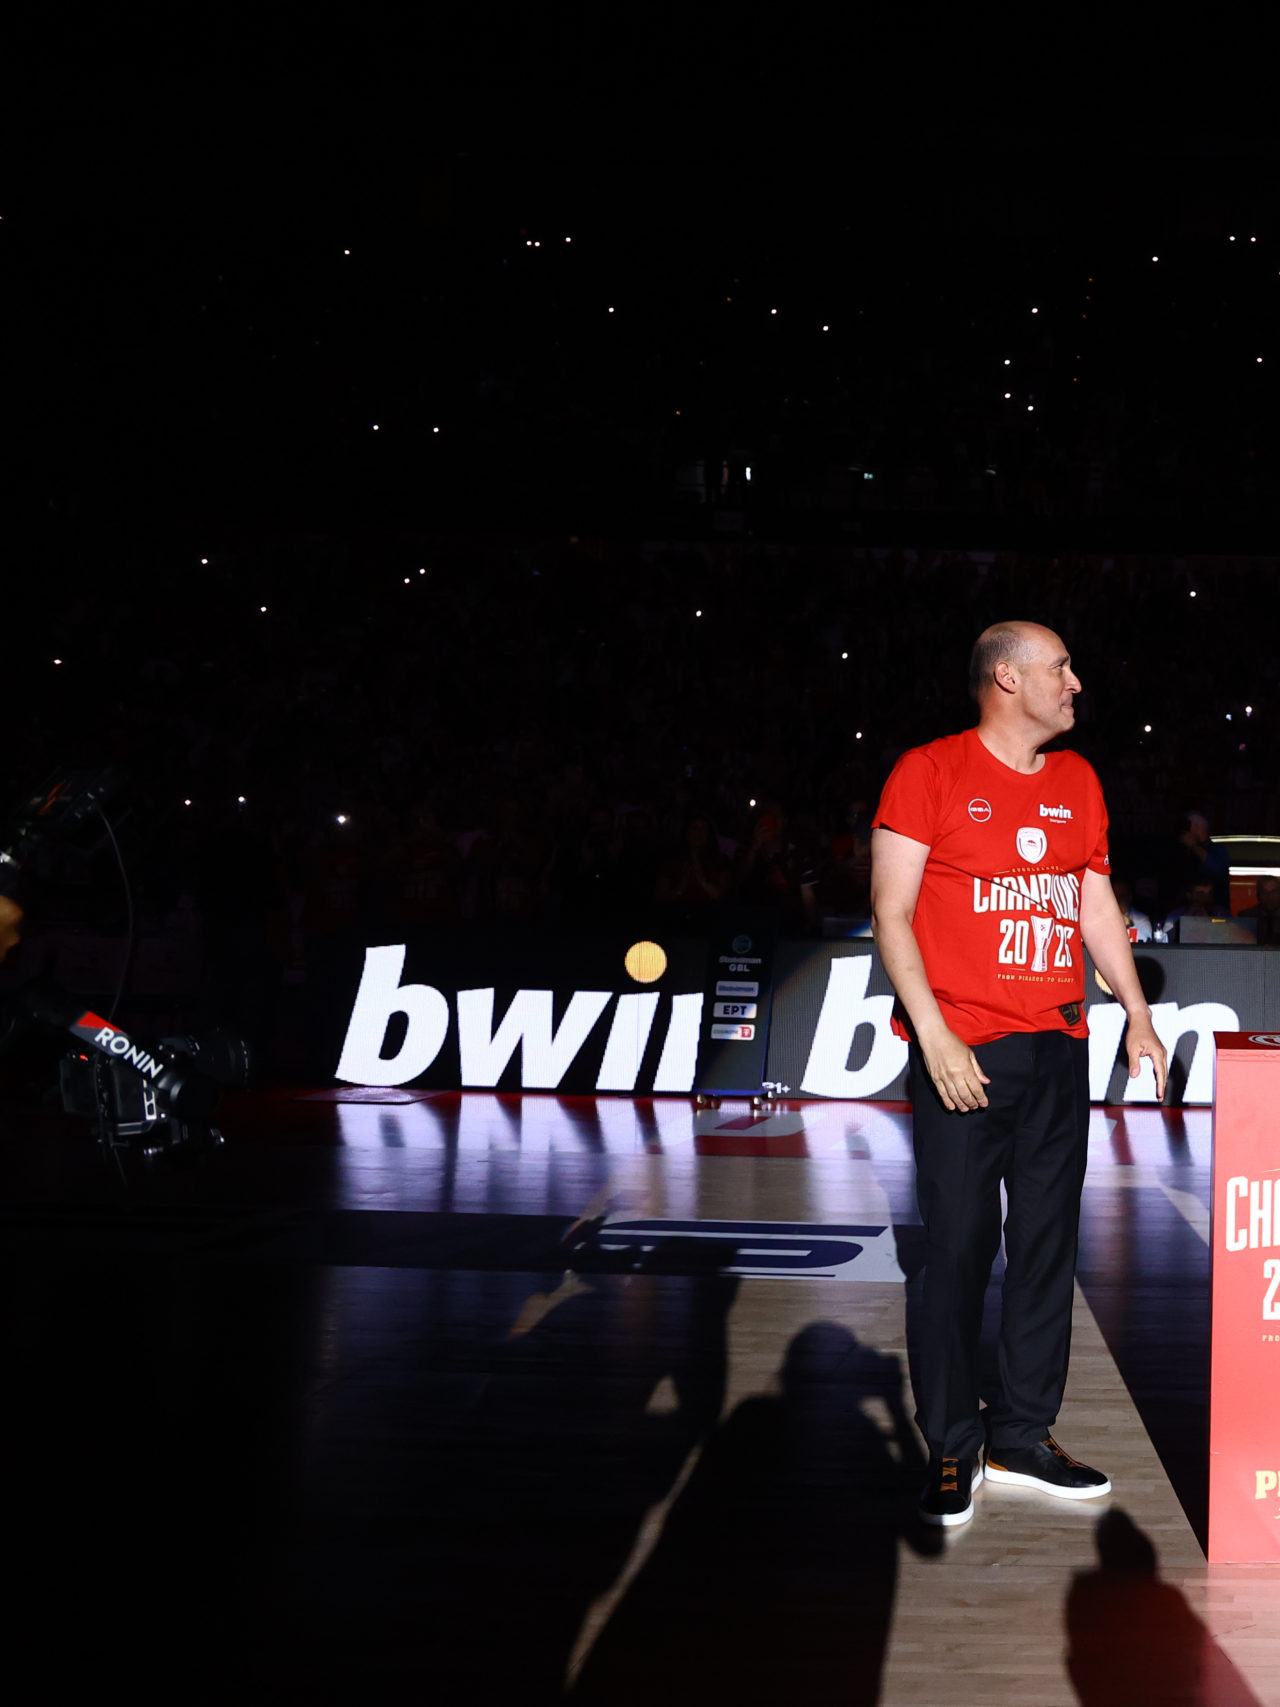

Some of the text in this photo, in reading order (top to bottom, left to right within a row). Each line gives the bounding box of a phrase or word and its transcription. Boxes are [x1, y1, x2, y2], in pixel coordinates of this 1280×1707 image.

[973, 872, 1080, 923] CHAMPIONS
[998, 918, 1030, 965] 20
[94, 1026, 164, 1080] RONIN
